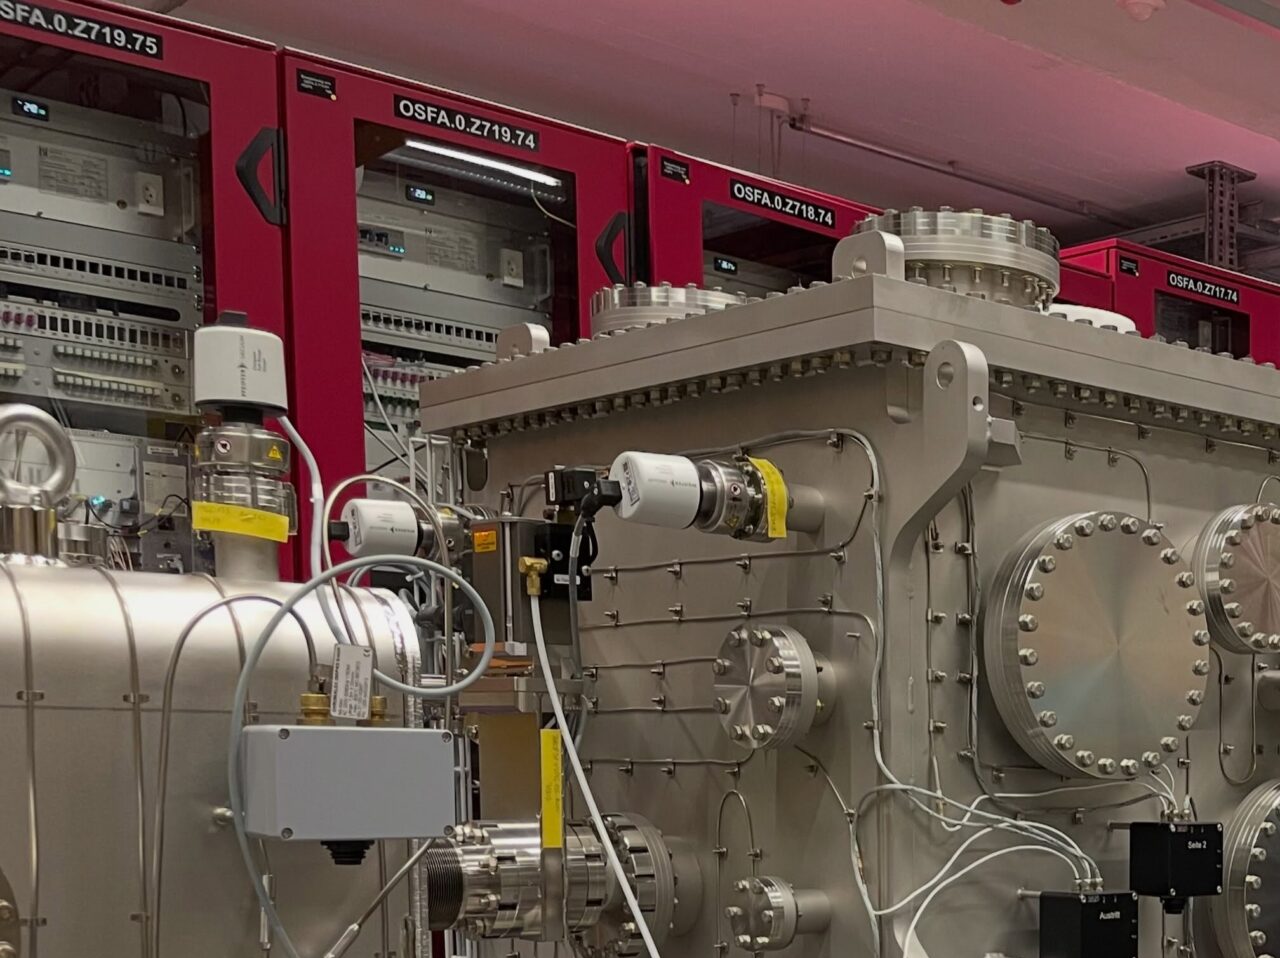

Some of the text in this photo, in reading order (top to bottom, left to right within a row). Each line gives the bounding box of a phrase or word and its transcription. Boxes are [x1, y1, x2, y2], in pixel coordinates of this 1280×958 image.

[0, 0, 158, 55] SFA.0.Z719.75
[399, 99, 536, 150] OSFA.0.Z719.74
[733, 183, 833, 226] OSFA.0.Z718.74
[1169, 273, 1238, 303] OSFA.0.Z717.74
